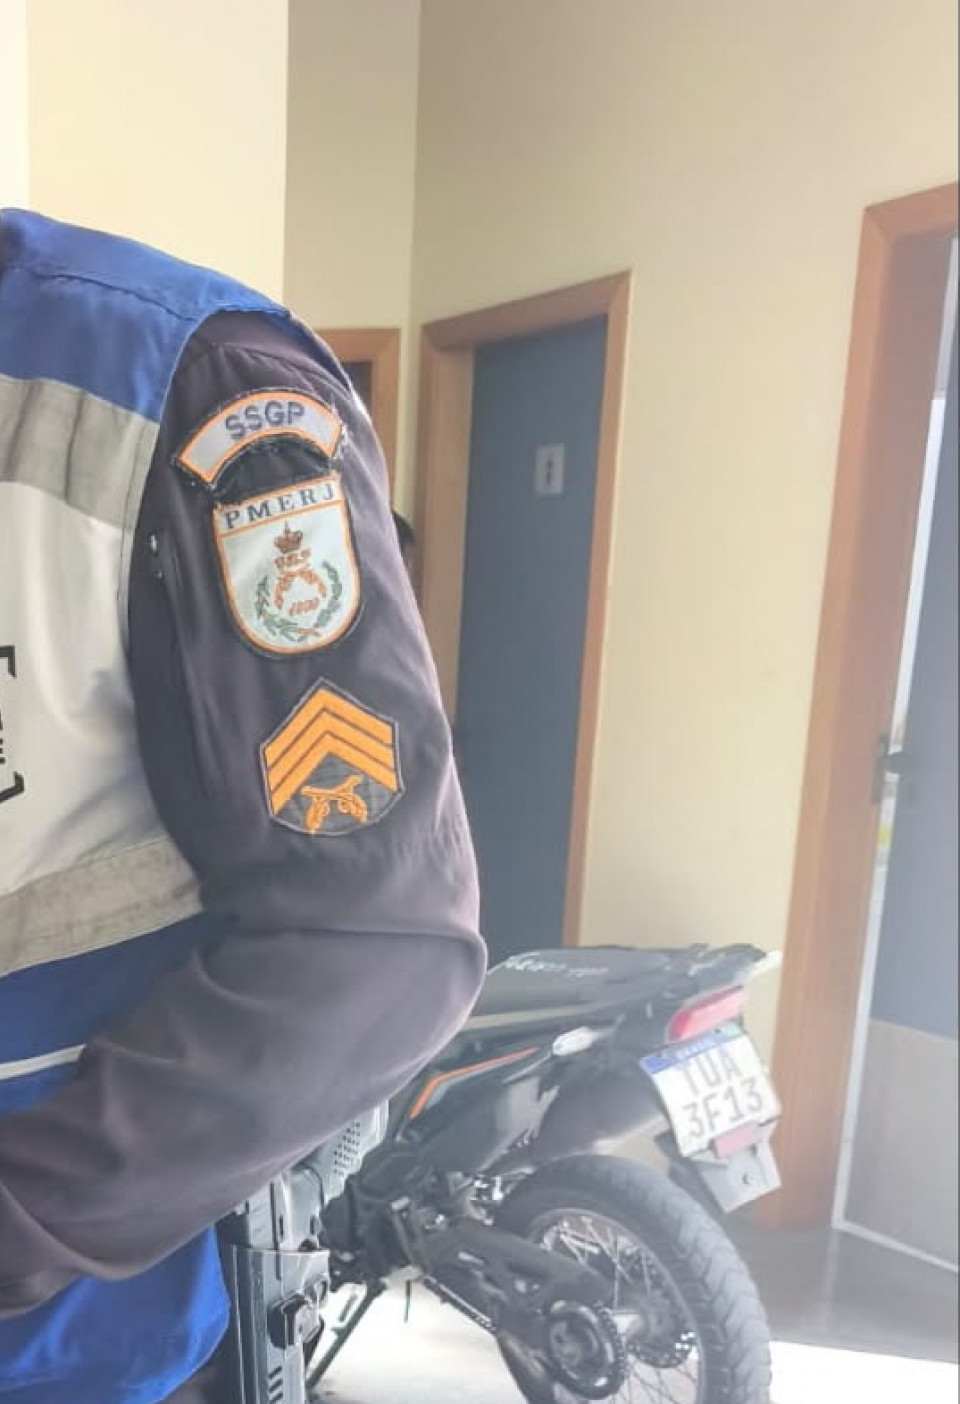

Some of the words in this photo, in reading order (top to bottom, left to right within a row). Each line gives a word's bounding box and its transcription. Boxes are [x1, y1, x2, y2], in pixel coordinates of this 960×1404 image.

[224, 402, 305, 440] SSGP
[224, 484, 335, 530] PMERJ
[681, 1077, 763, 1138] 3F13
